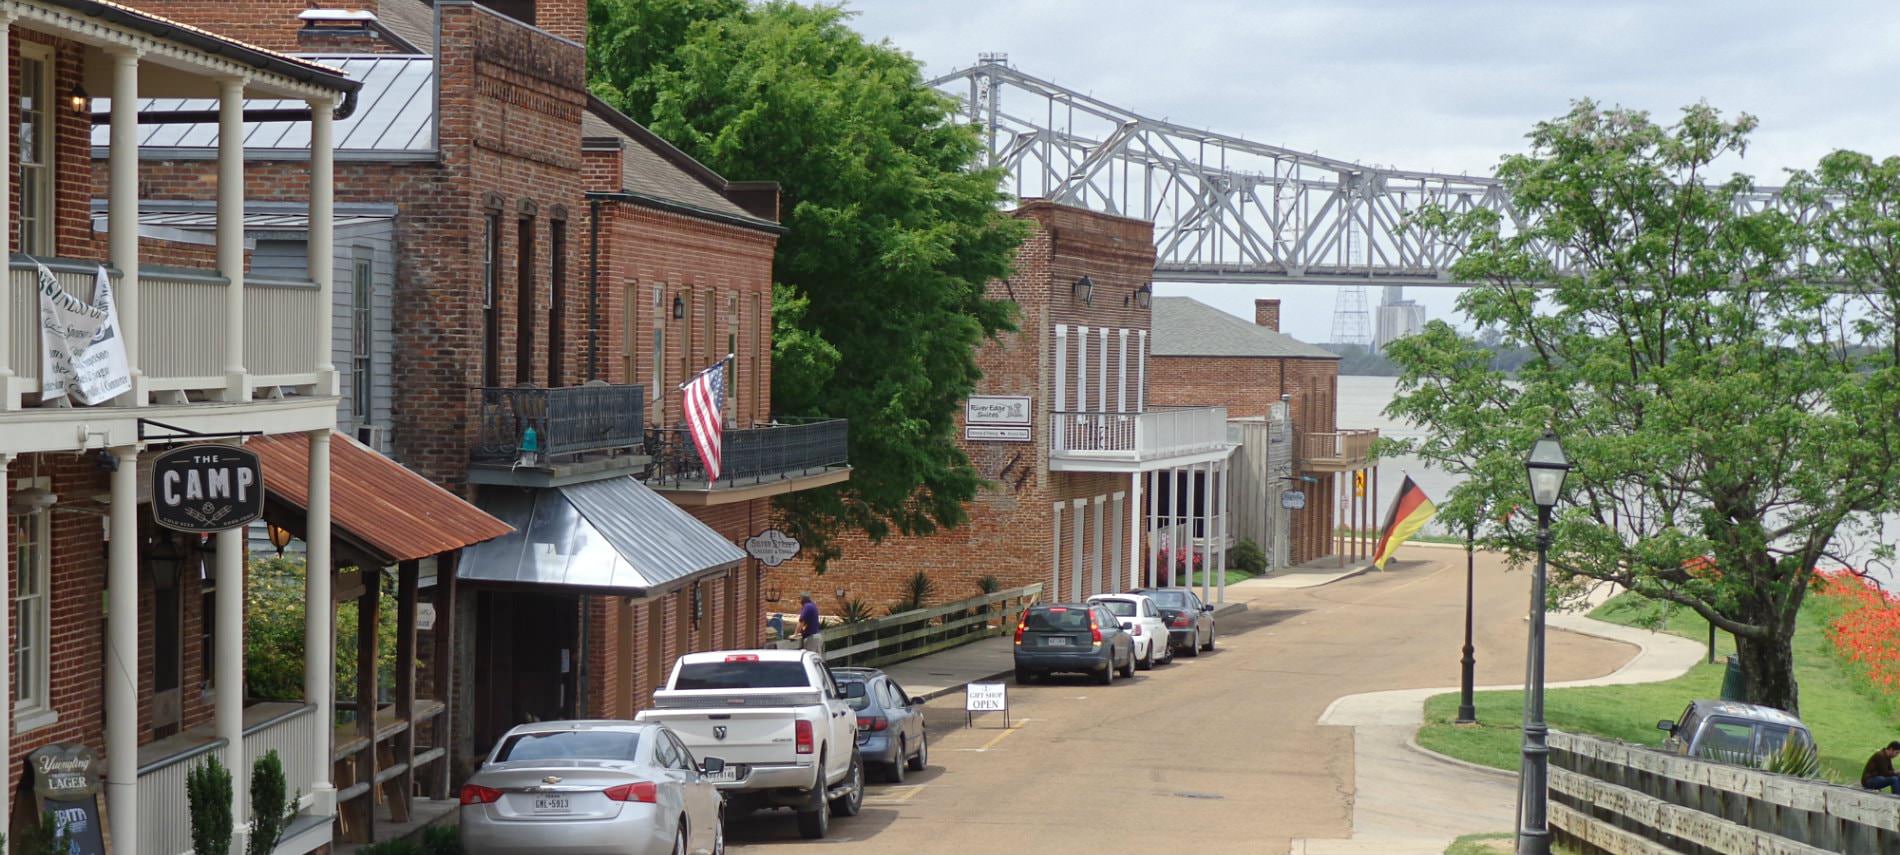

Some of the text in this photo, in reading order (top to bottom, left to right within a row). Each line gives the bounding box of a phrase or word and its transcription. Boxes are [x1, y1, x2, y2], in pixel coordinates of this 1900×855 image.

[193, 455, 220, 463] THE
[163, 467, 255, 506] CAMP
[972, 700, 999, 709] OPEN
[40, 755, 91, 774] Yuengling
[48, 777, 87, 790] LAGER
